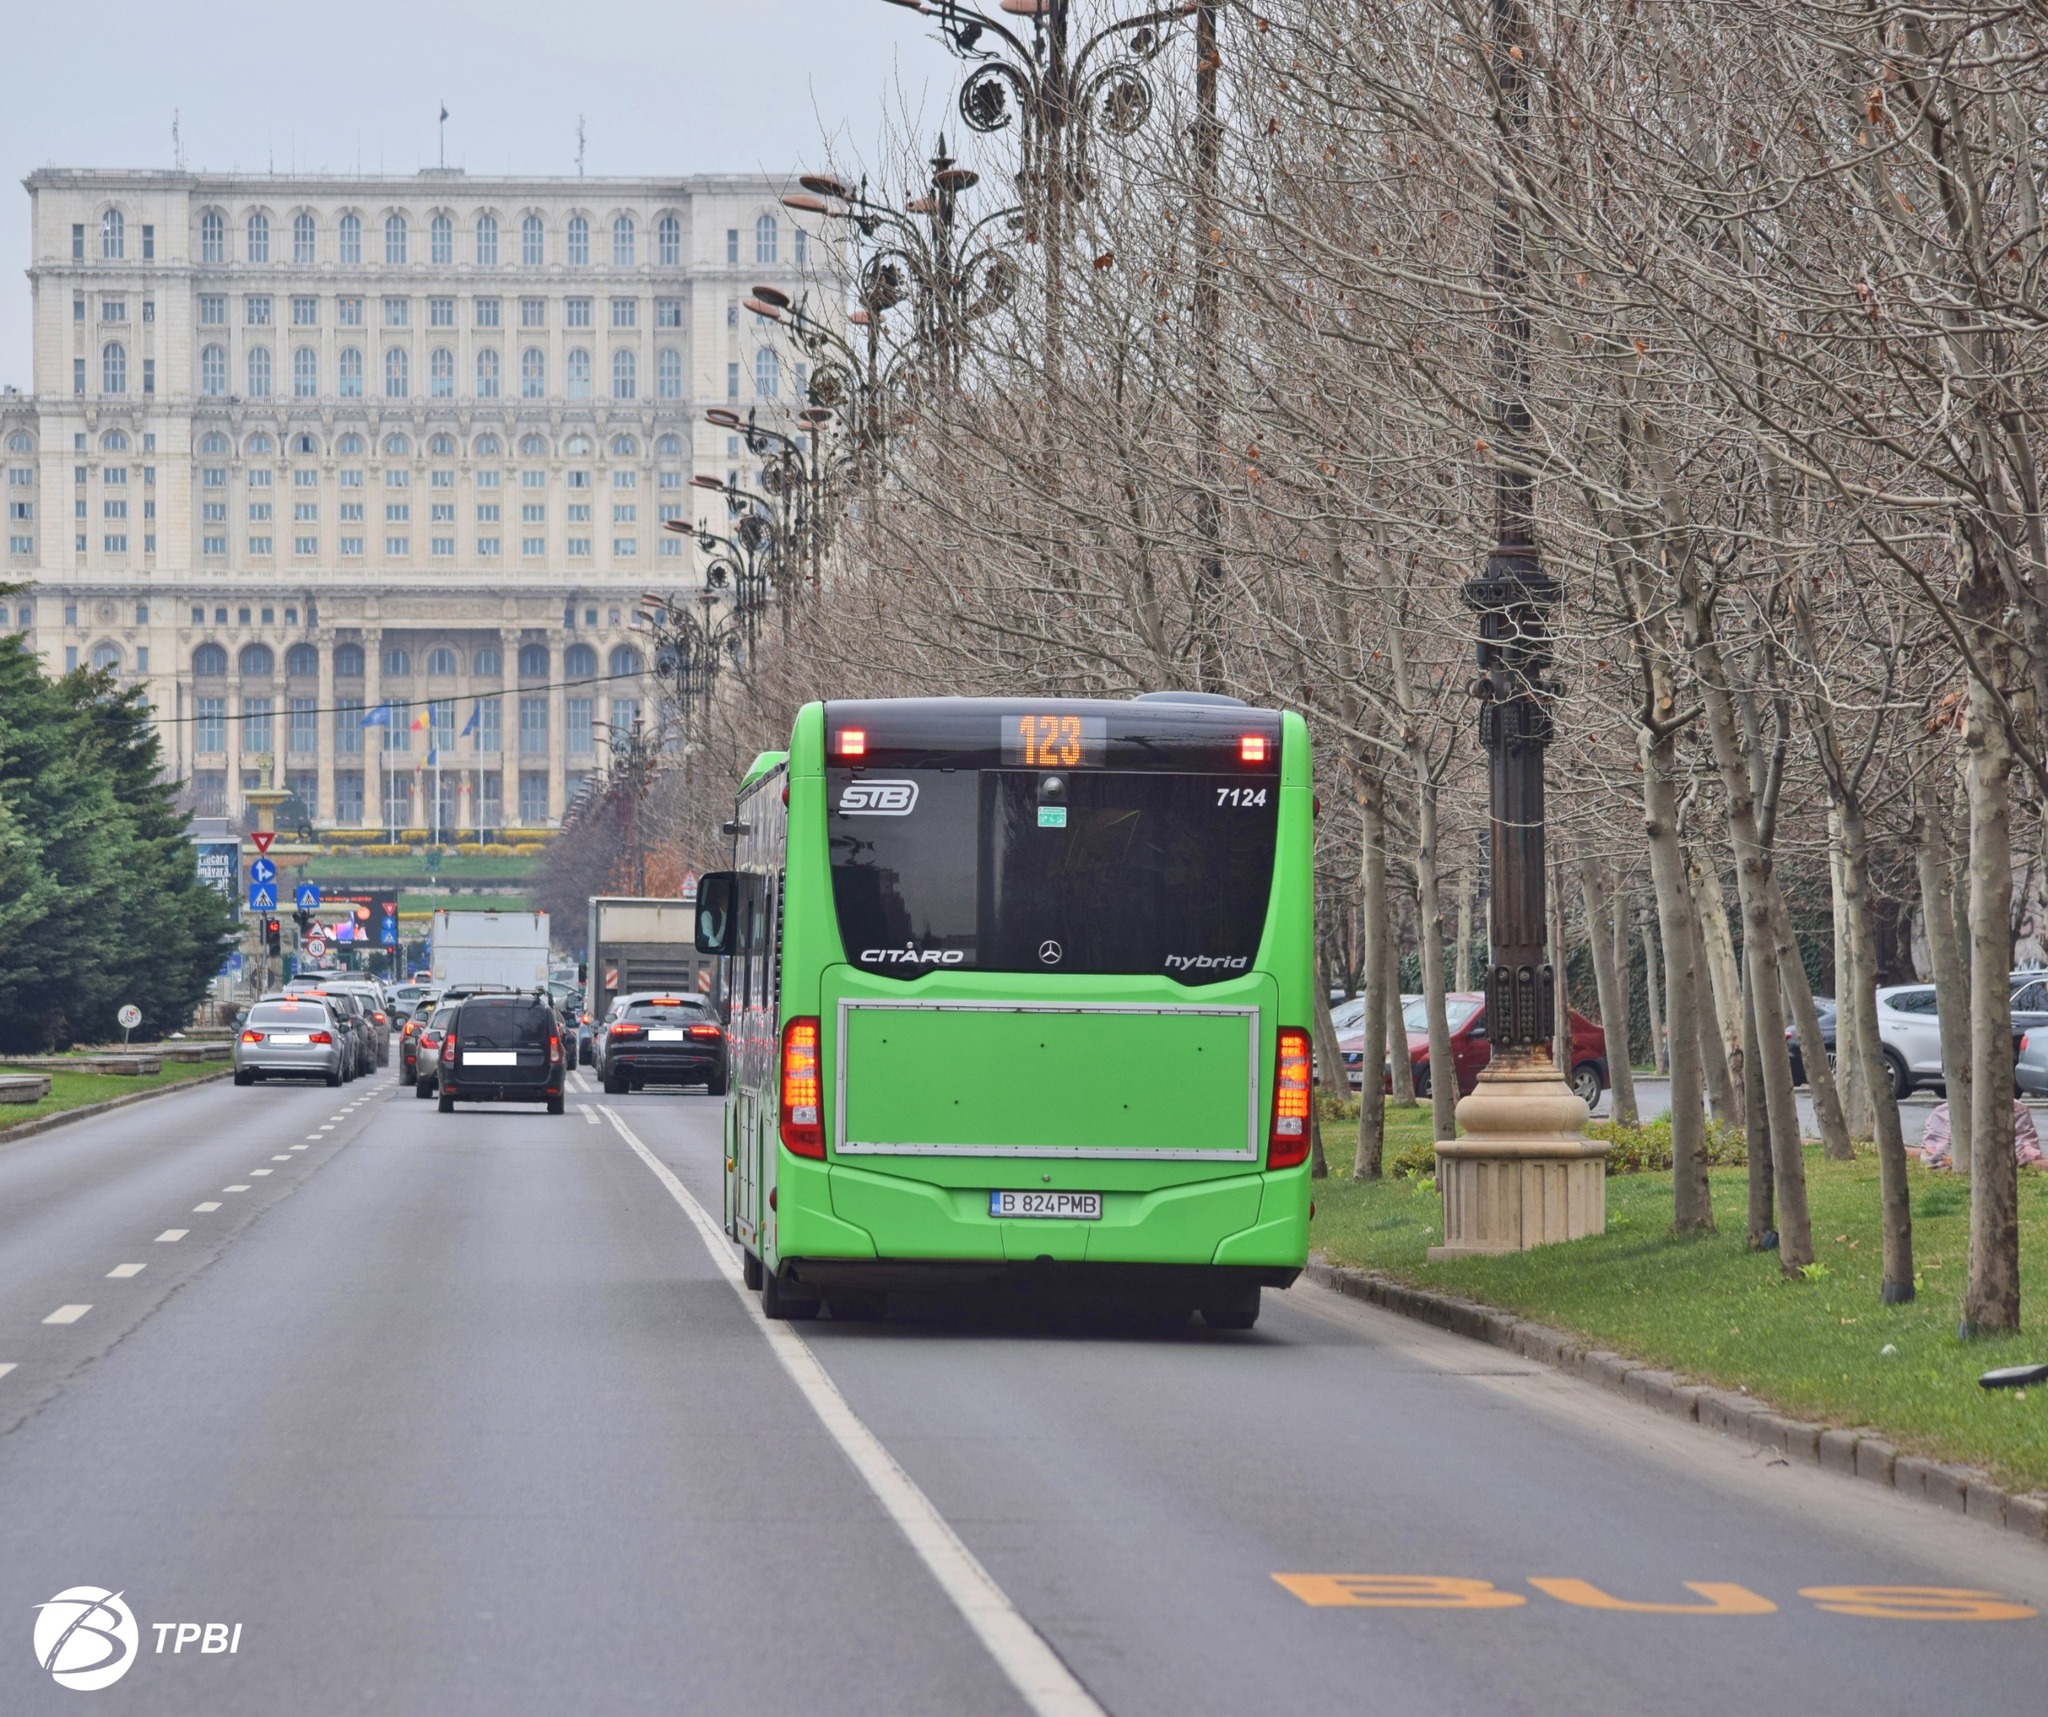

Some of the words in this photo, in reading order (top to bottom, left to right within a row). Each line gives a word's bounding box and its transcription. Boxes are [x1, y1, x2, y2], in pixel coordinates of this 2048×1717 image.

[1020, 715, 1080, 765] 123
[839, 786, 911, 808] STB
[1217, 788, 1267, 807] 7124
[312, 943, 322, 953] 30
[860, 949, 964, 963] CITARO
[1164, 954, 1248, 971] hybrid
[1003, 1194, 1016, 1212] B
[1270, 1572, 2038, 1621] BUS
